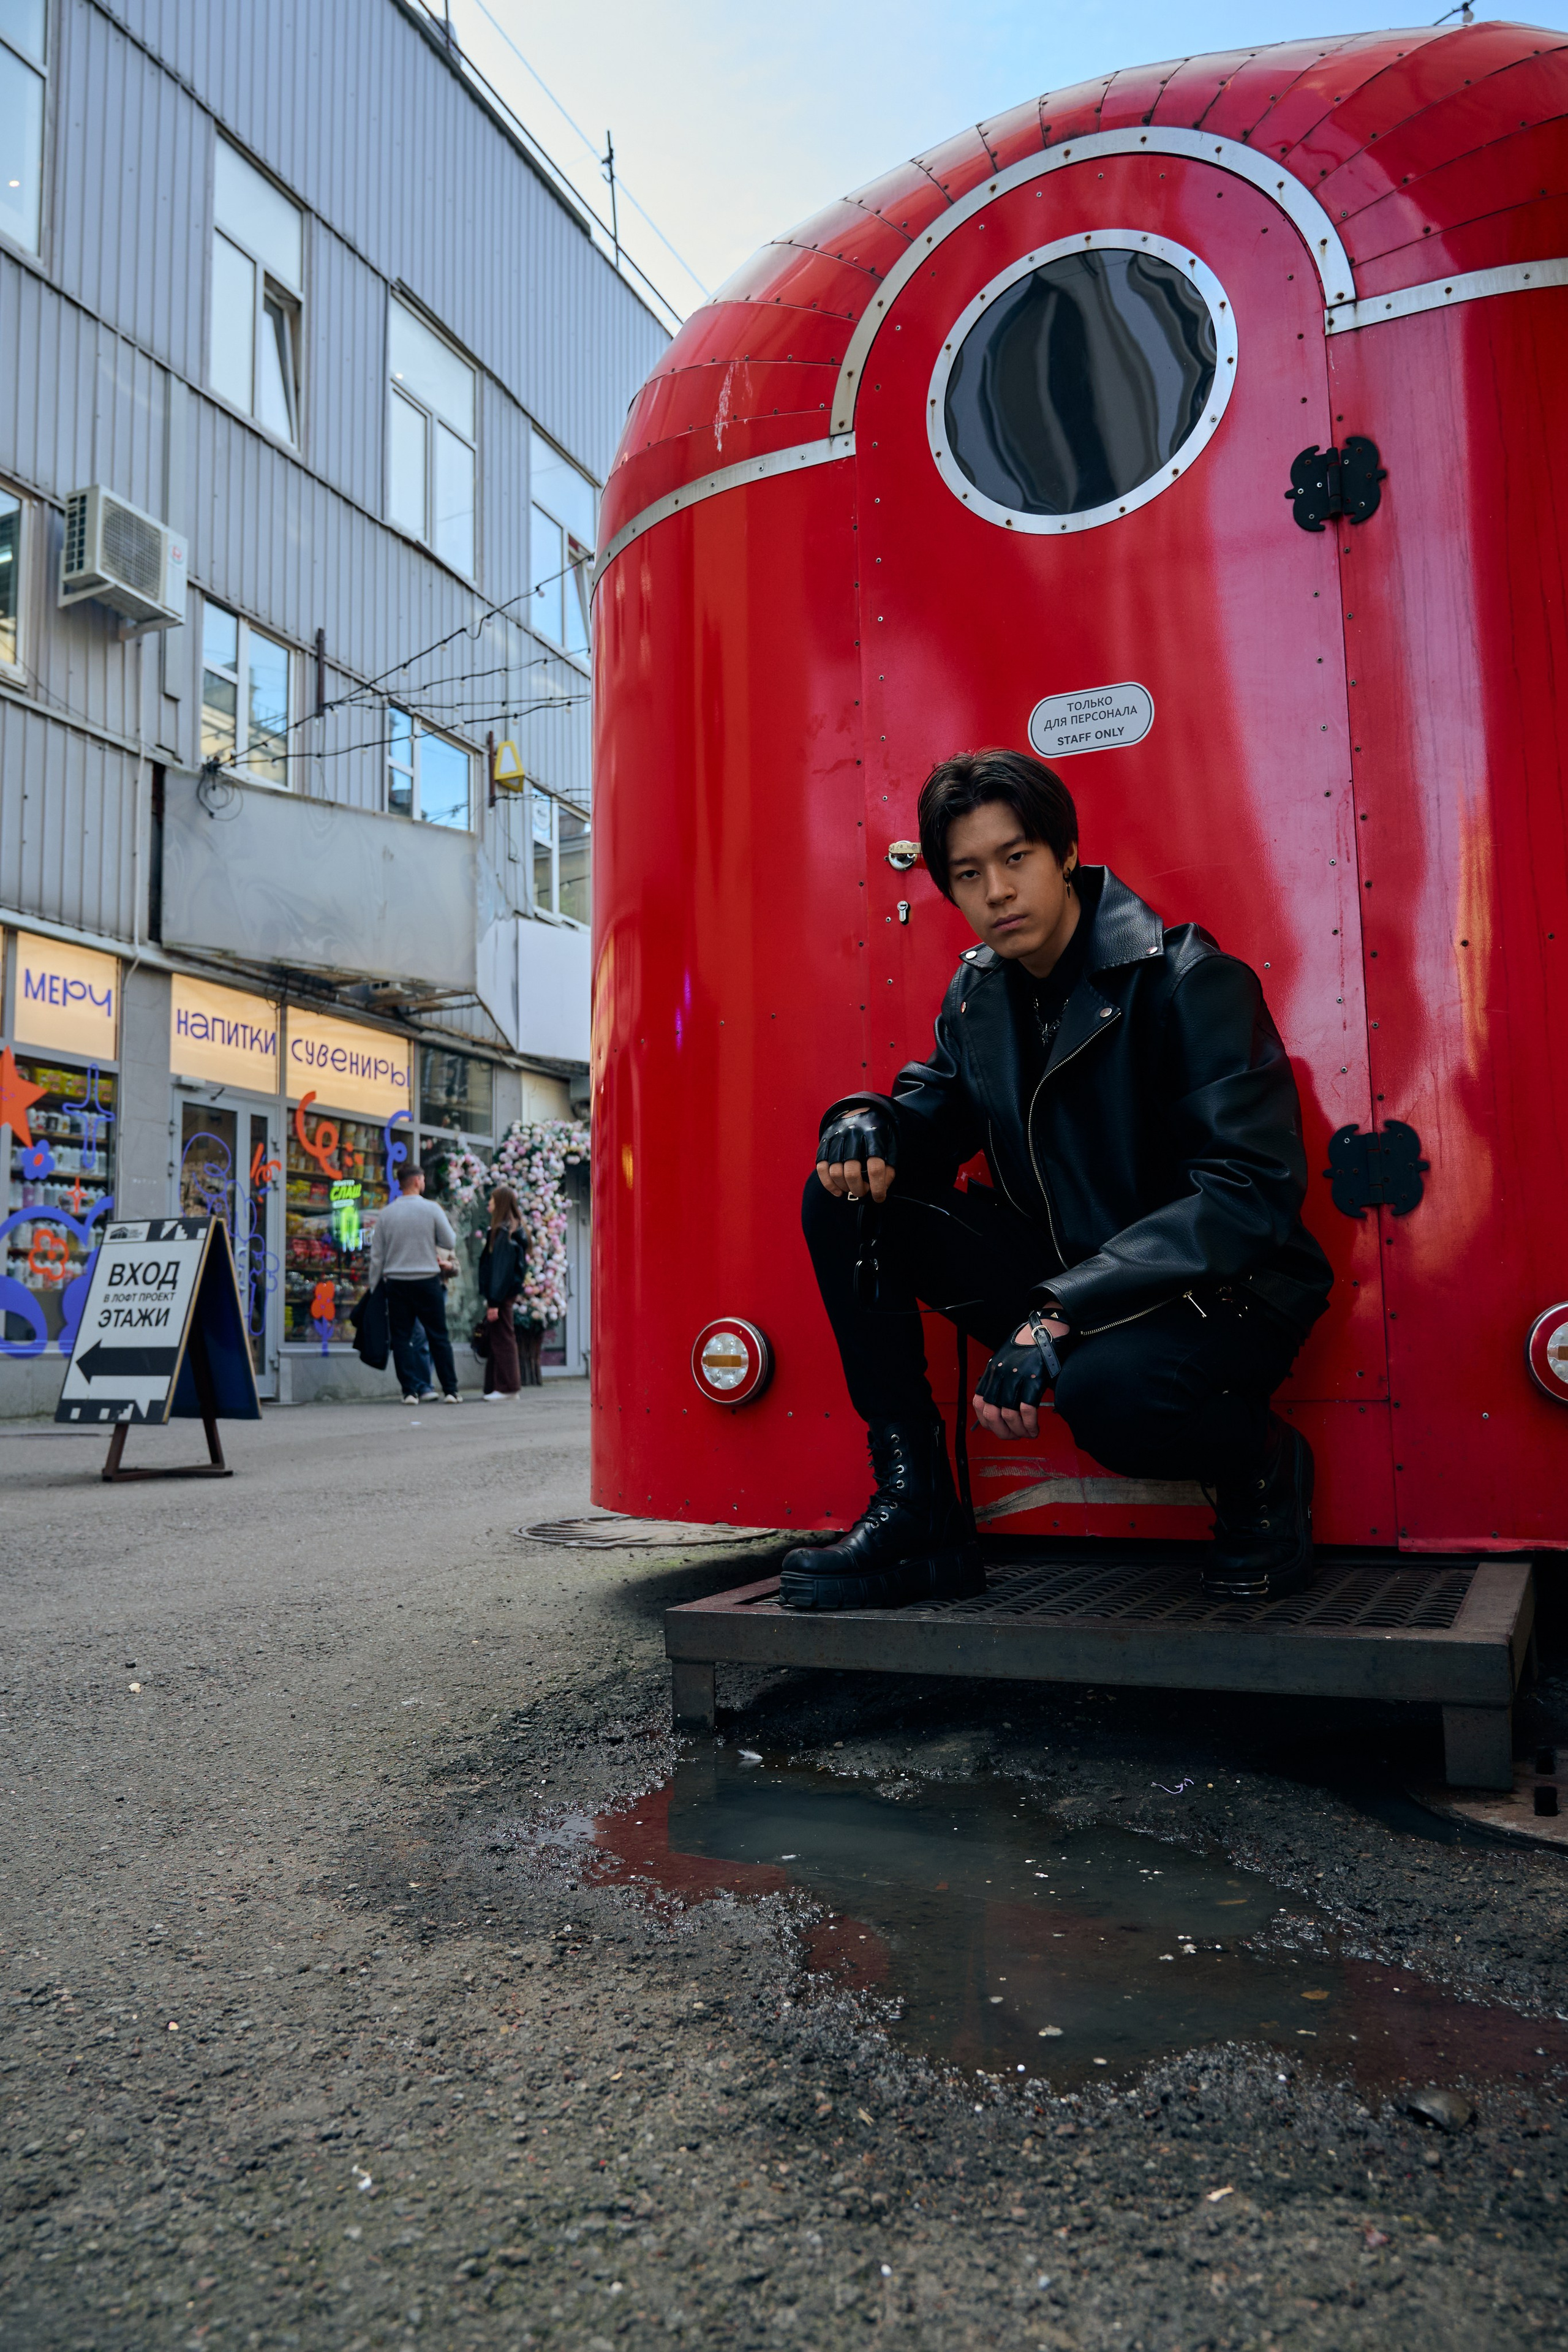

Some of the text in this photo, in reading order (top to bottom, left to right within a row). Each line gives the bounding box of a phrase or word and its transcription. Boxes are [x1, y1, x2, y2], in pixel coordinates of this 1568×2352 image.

[1067, 696, 1112, 712] ТОЛЬКО
[1044, 705, 1137, 731] ДЛЯ ПЕРСОНАЛА
[1057, 726, 1125, 745] STAFF ONLY
[330, 1183, 362, 1202] СЛАШ
[108, 1261, 181, 1291] ВХОД
[104, 1292, 176, 1303] В ЛОФТ ПРОЕКТ
[98, 1308, 171, 1328] ЭТАЖИ
